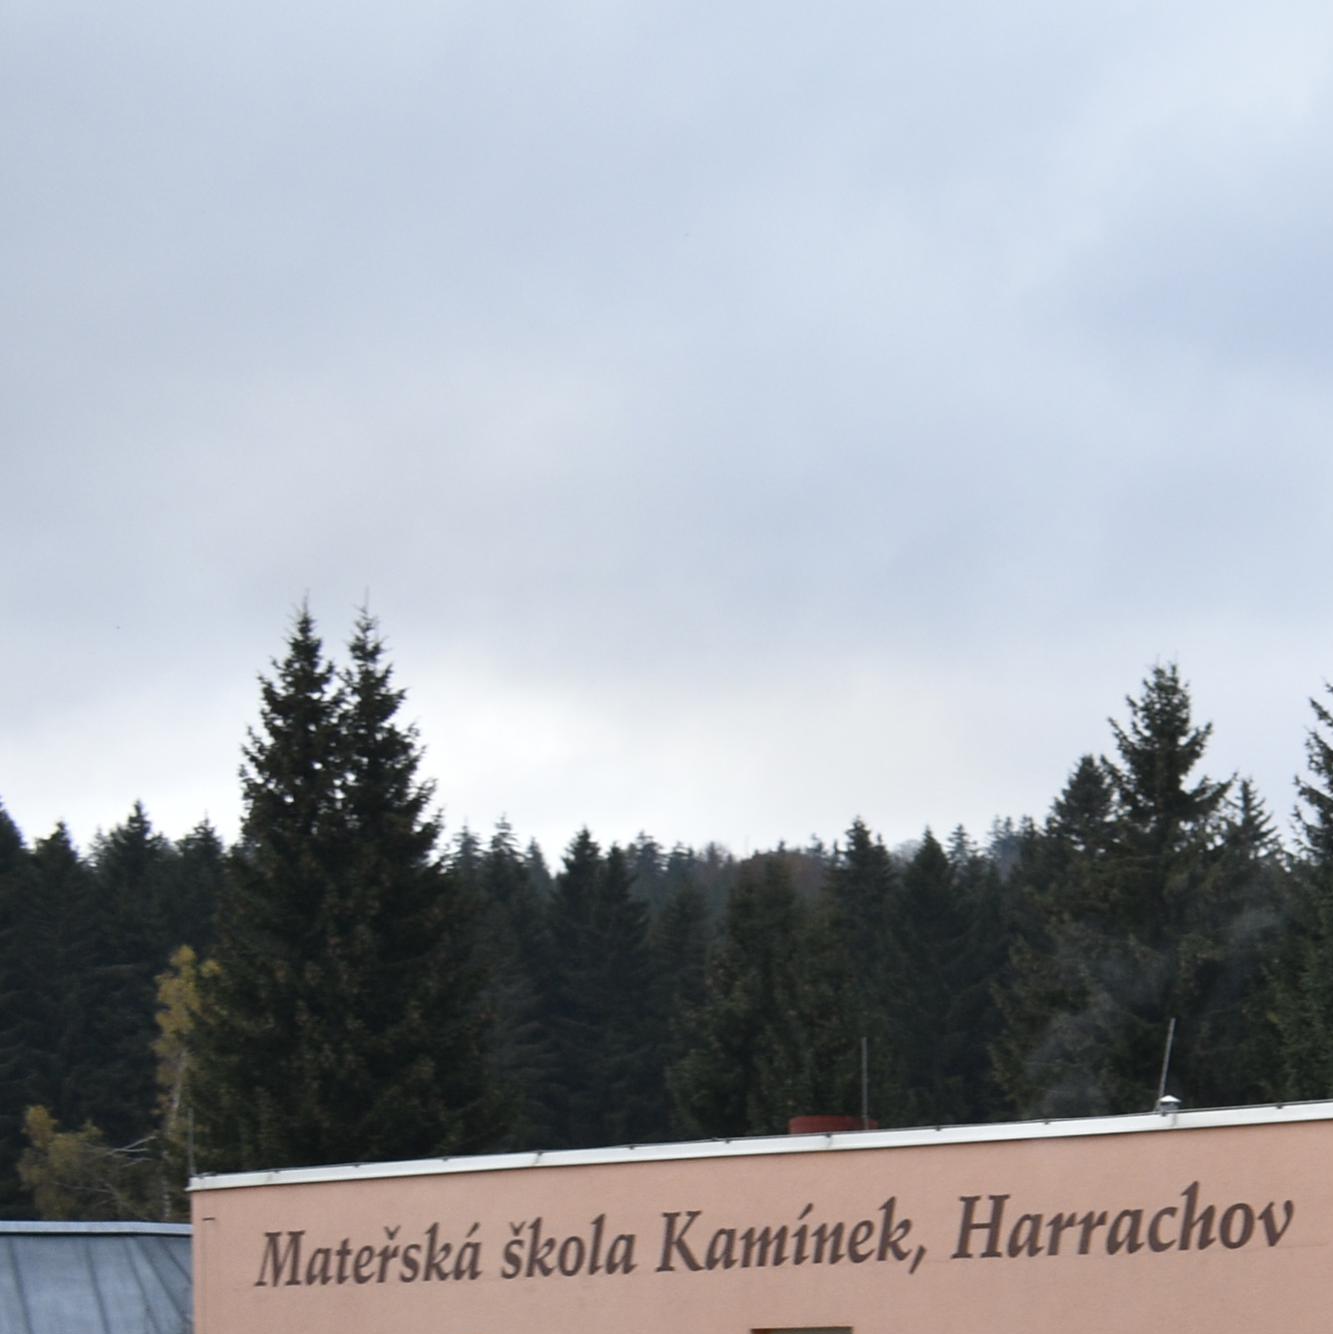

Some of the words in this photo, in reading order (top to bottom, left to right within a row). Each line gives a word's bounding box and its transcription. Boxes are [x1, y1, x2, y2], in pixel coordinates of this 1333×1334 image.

[254, 1221, 482, 1288] Mateřská
[500, 1213, 637, 1281] škola
[655, 1196, 927, 1275] Kamínek,
[950, 1180, 1295, 1260] Harrachov
